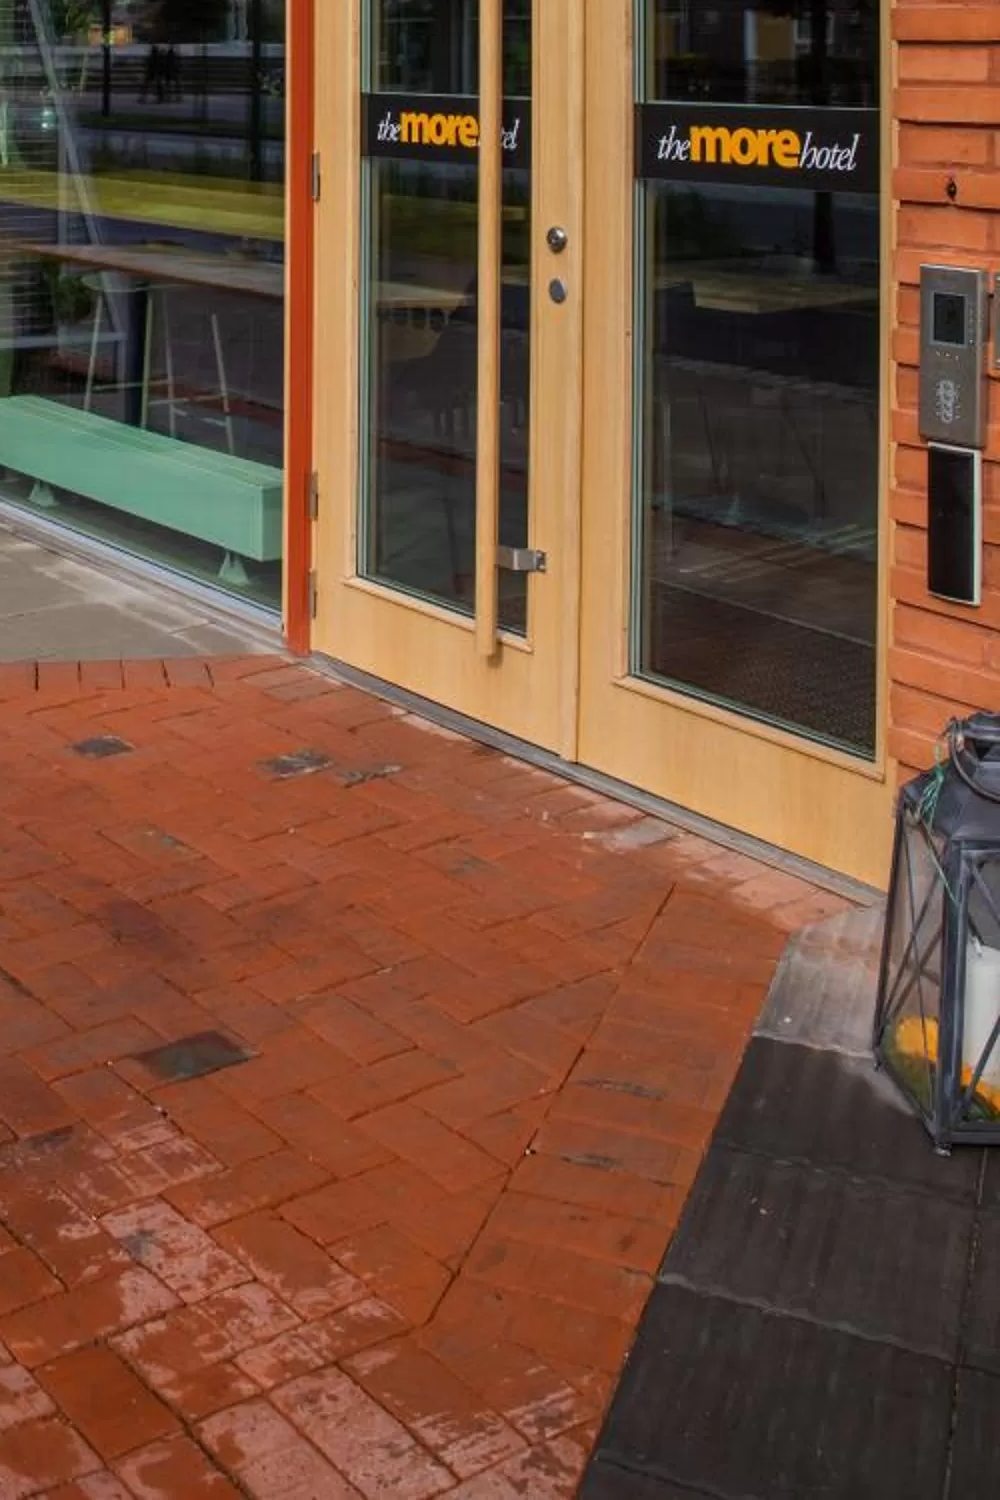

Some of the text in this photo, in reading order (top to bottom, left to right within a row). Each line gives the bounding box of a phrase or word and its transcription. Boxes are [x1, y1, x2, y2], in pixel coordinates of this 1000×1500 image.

[400, 111, 479, 148] more
[657, 126, 860, 171] the more hotel
